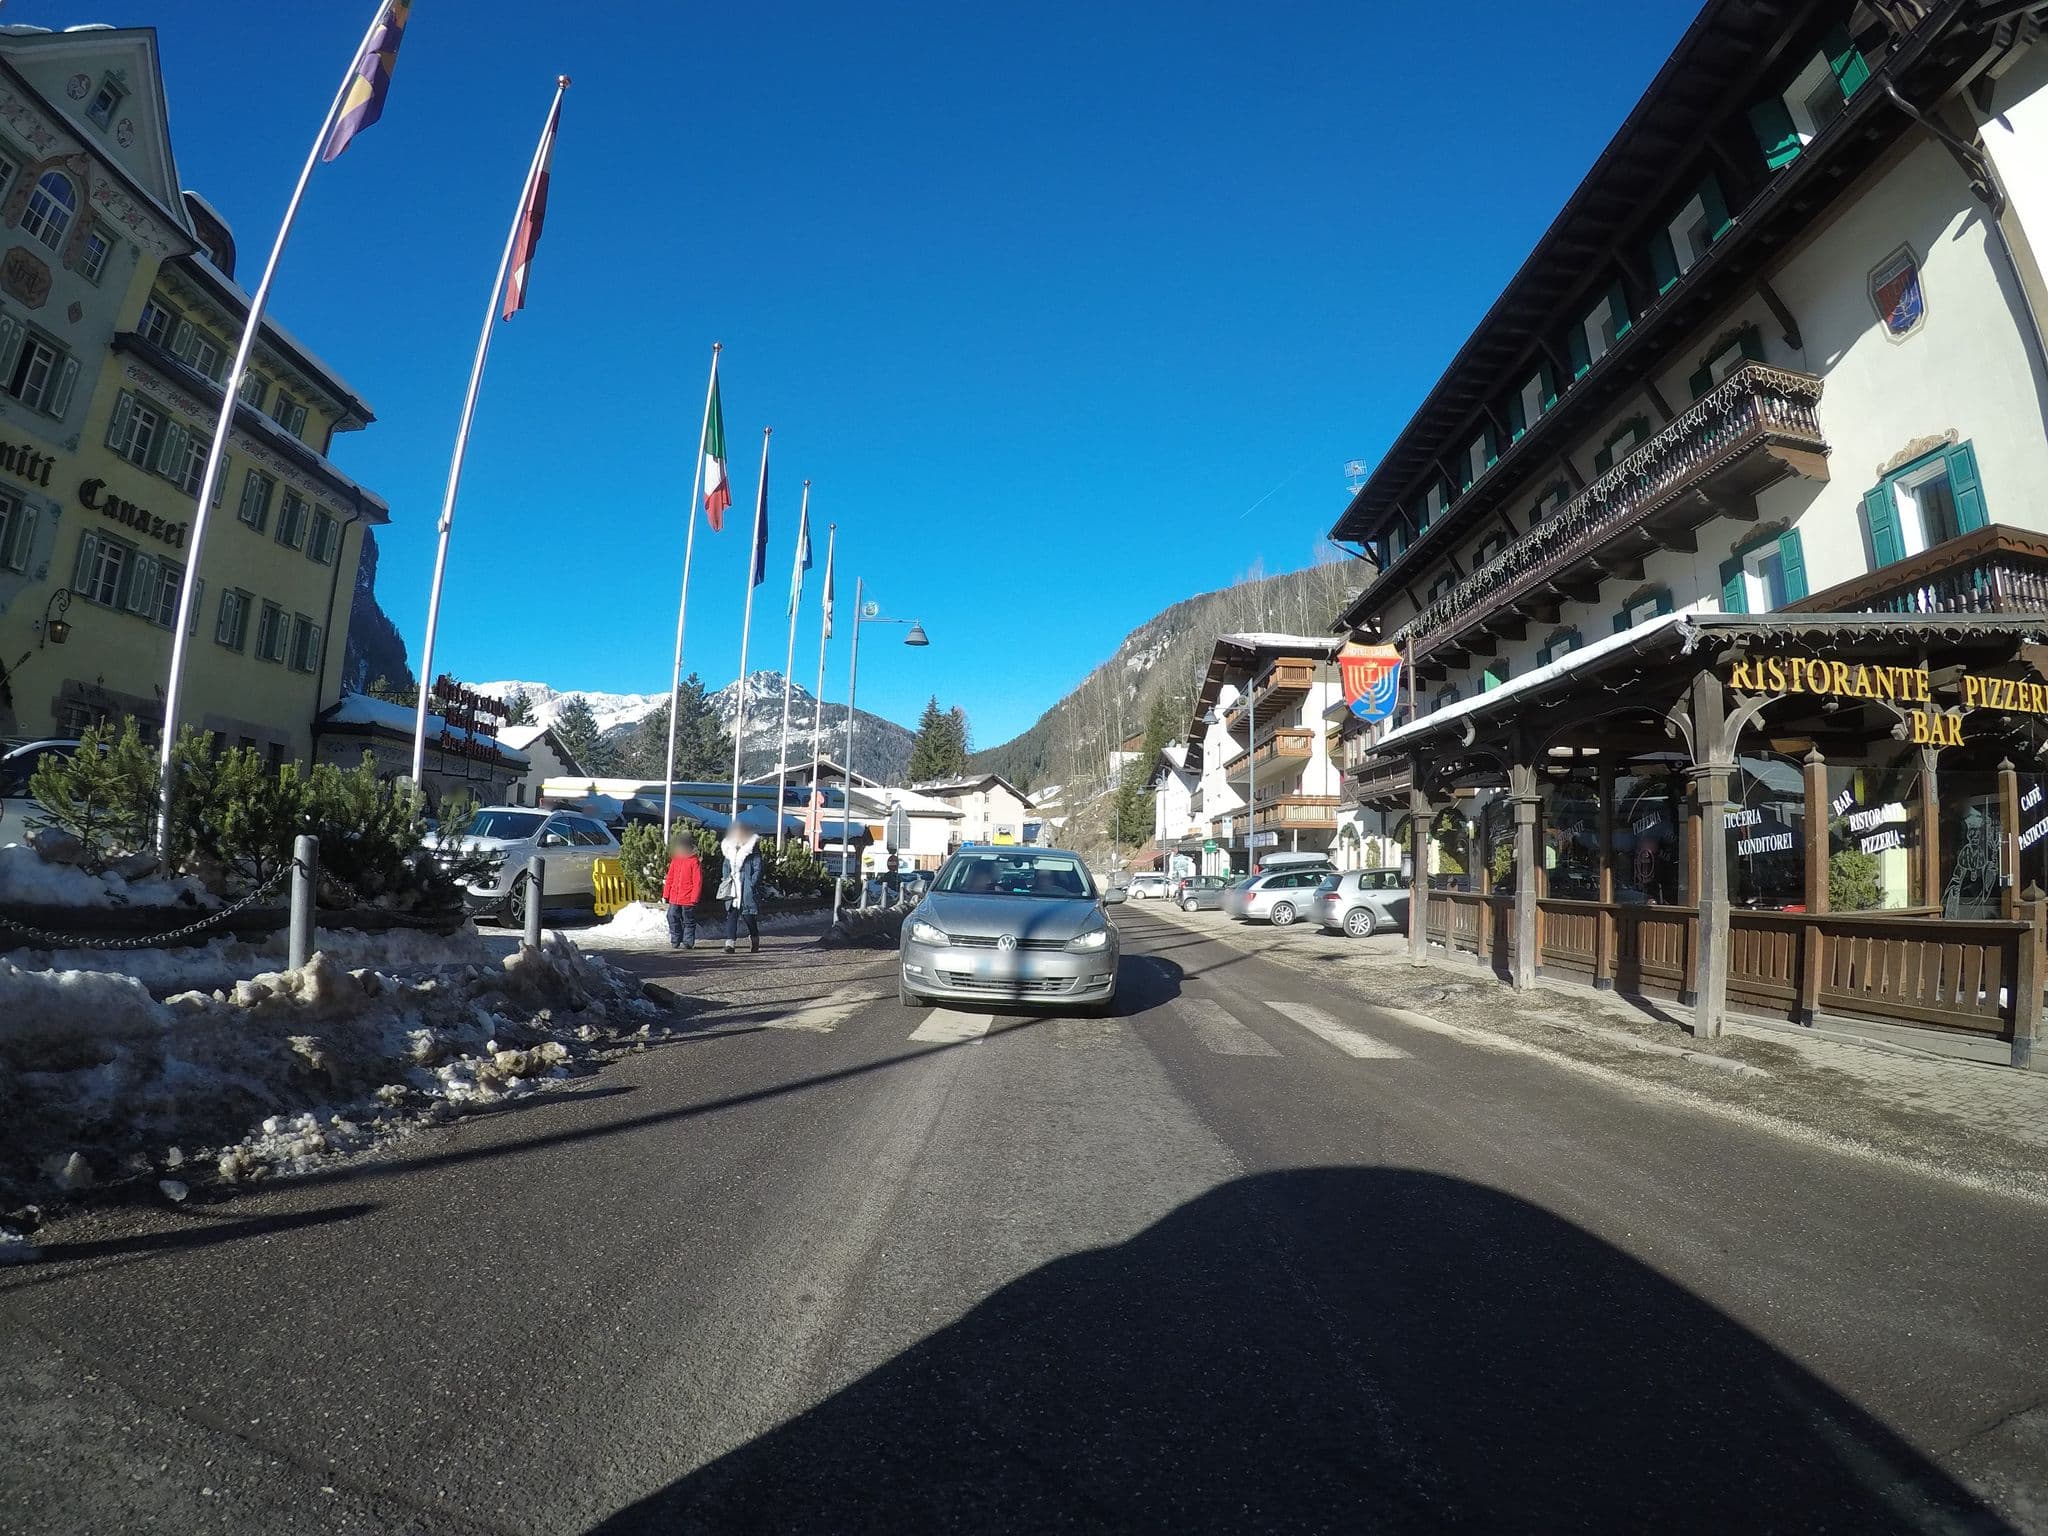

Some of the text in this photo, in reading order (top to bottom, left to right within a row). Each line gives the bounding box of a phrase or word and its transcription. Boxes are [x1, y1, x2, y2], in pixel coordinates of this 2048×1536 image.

[79, 479, 188, 549] Canazei
[1731, 656, 1931, 702] RISTORANTE
[1912, 710, 1965, 747] BAR
[1832, 790, 1853, 816] BAR
[1860, 829, 1901, 855] PIZZERIA
